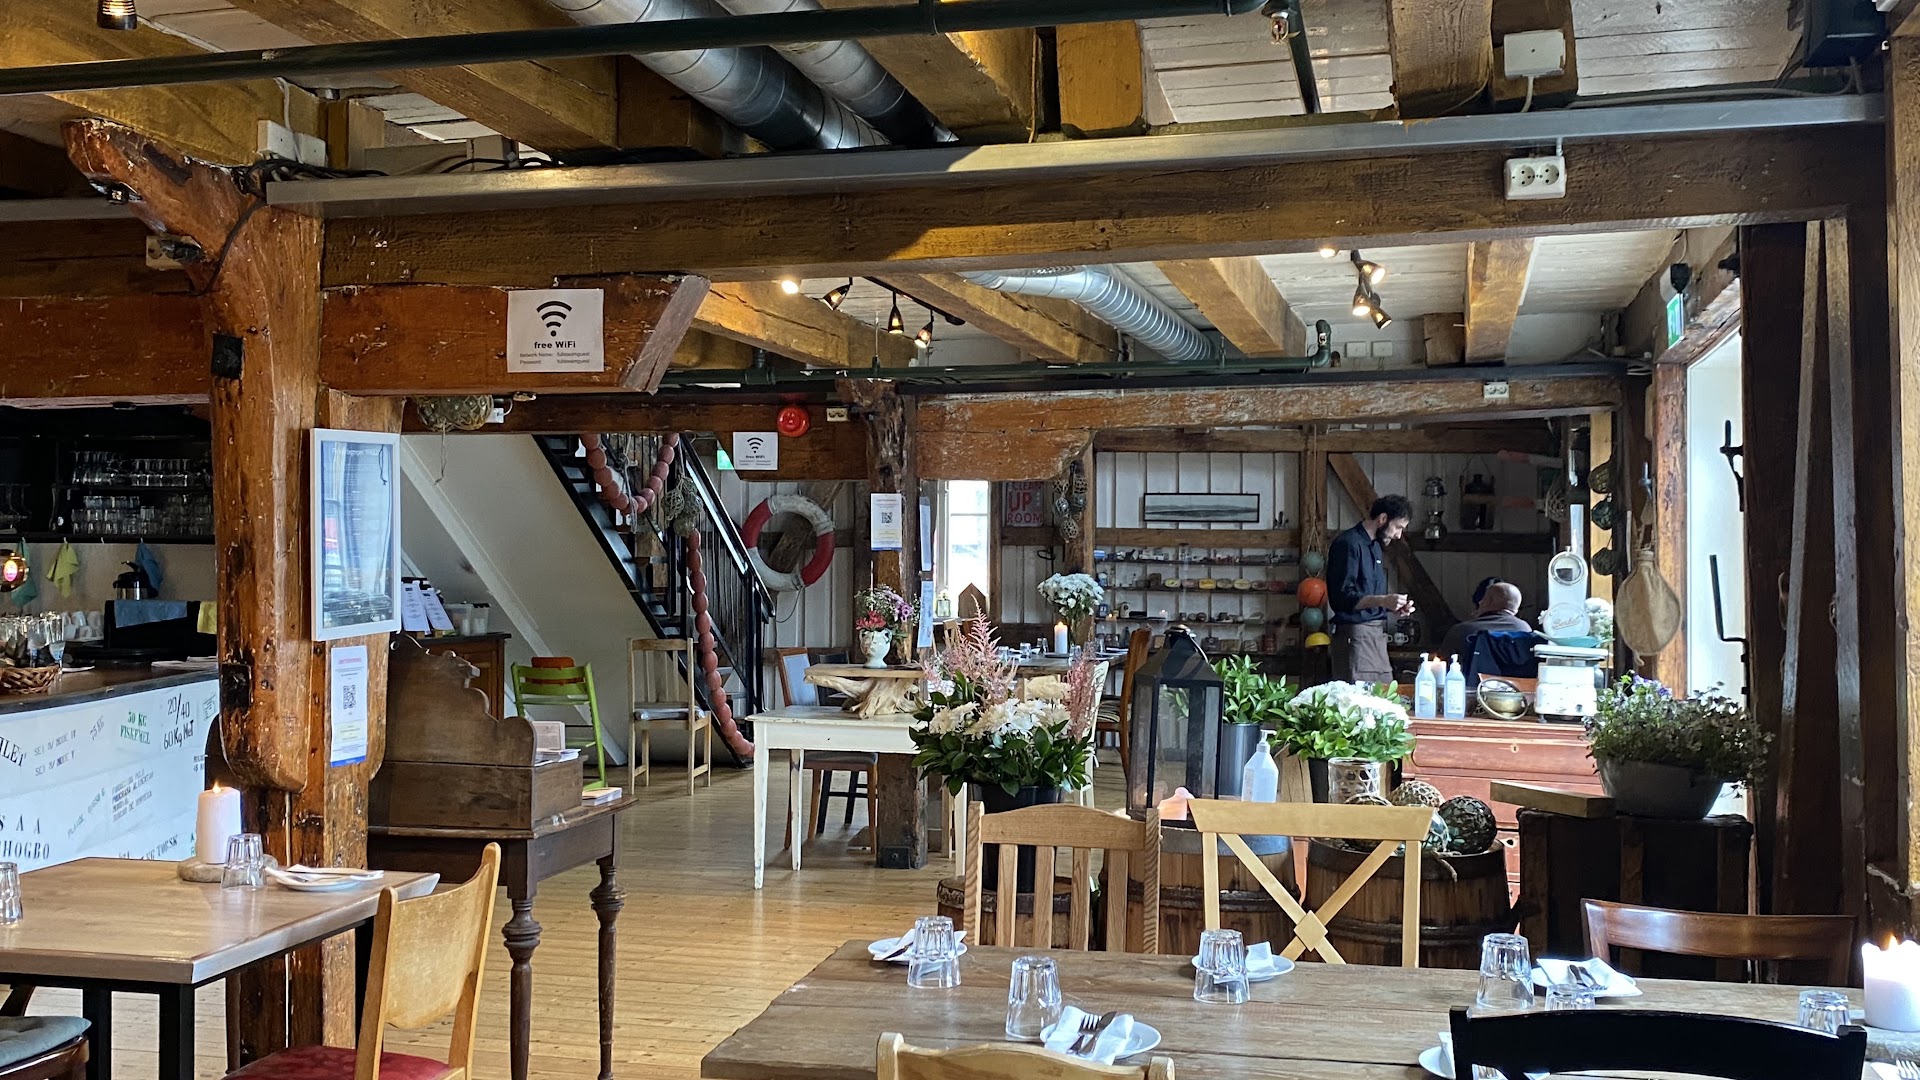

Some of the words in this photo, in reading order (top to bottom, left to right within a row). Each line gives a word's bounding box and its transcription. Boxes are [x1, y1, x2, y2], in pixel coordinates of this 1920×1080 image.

[534, 341, 553, 349] free
[555, 340, 577, 349] WiFi
[1009, 492, 1033, 512] UP
[1007, 513, 1044, 523] ROOM
[0, 840, 50, 860] HOGBO
